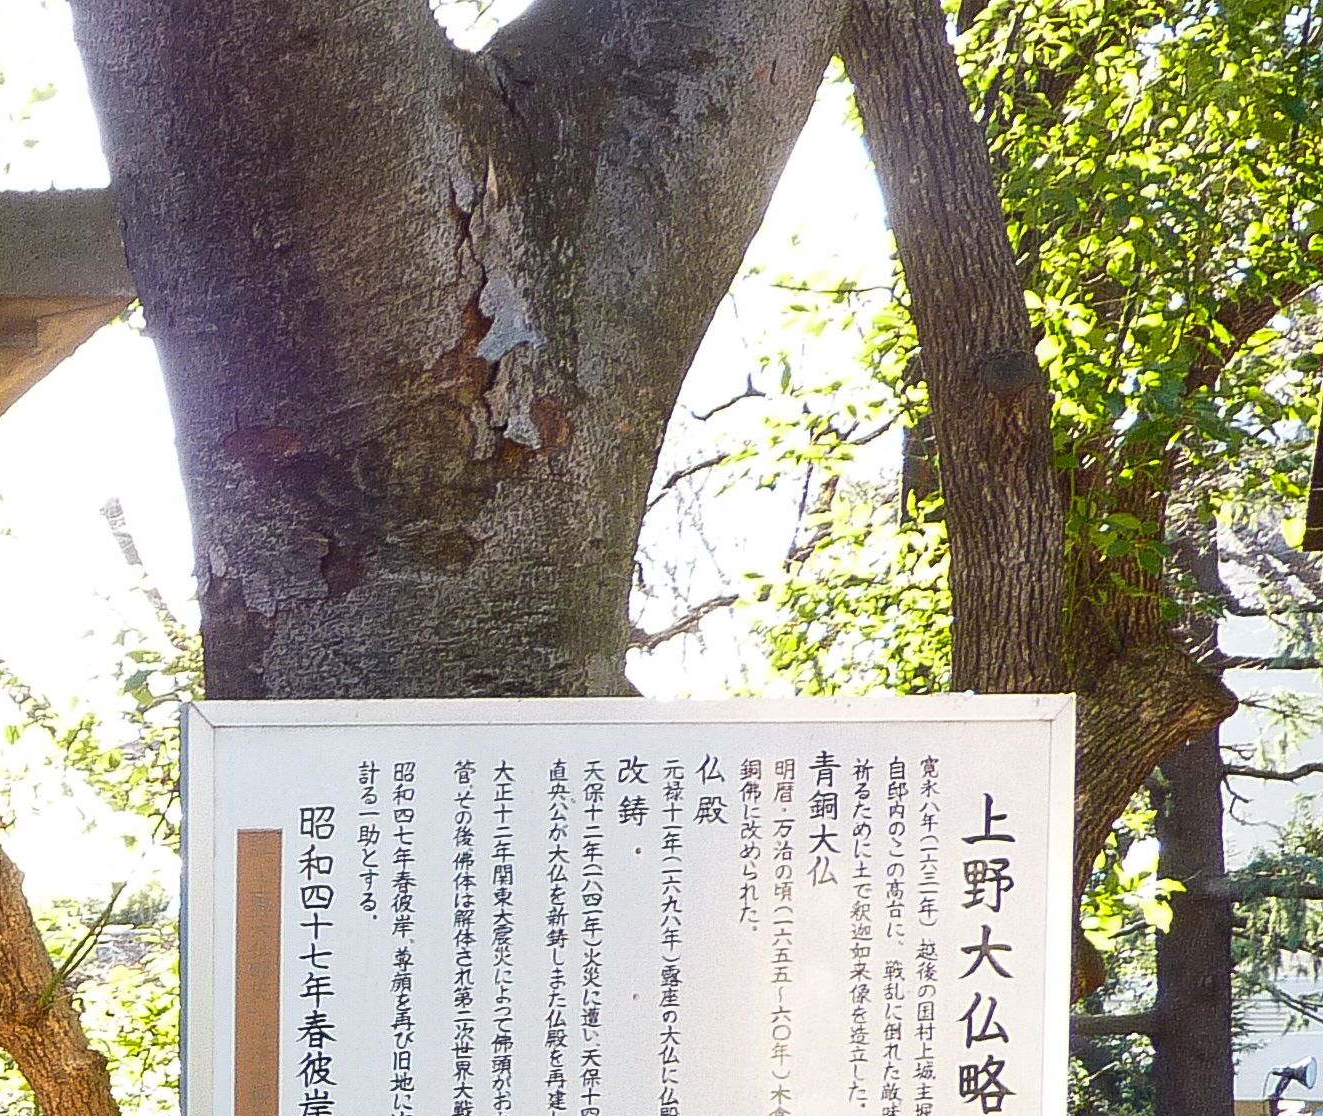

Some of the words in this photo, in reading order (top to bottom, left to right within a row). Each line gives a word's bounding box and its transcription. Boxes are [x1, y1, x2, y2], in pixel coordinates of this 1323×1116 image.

[617, 754, 651, 828] 改鋳
[692, 752, 729, 826] 仏殿
[806, 749, 843, 888] 青銅大仏
